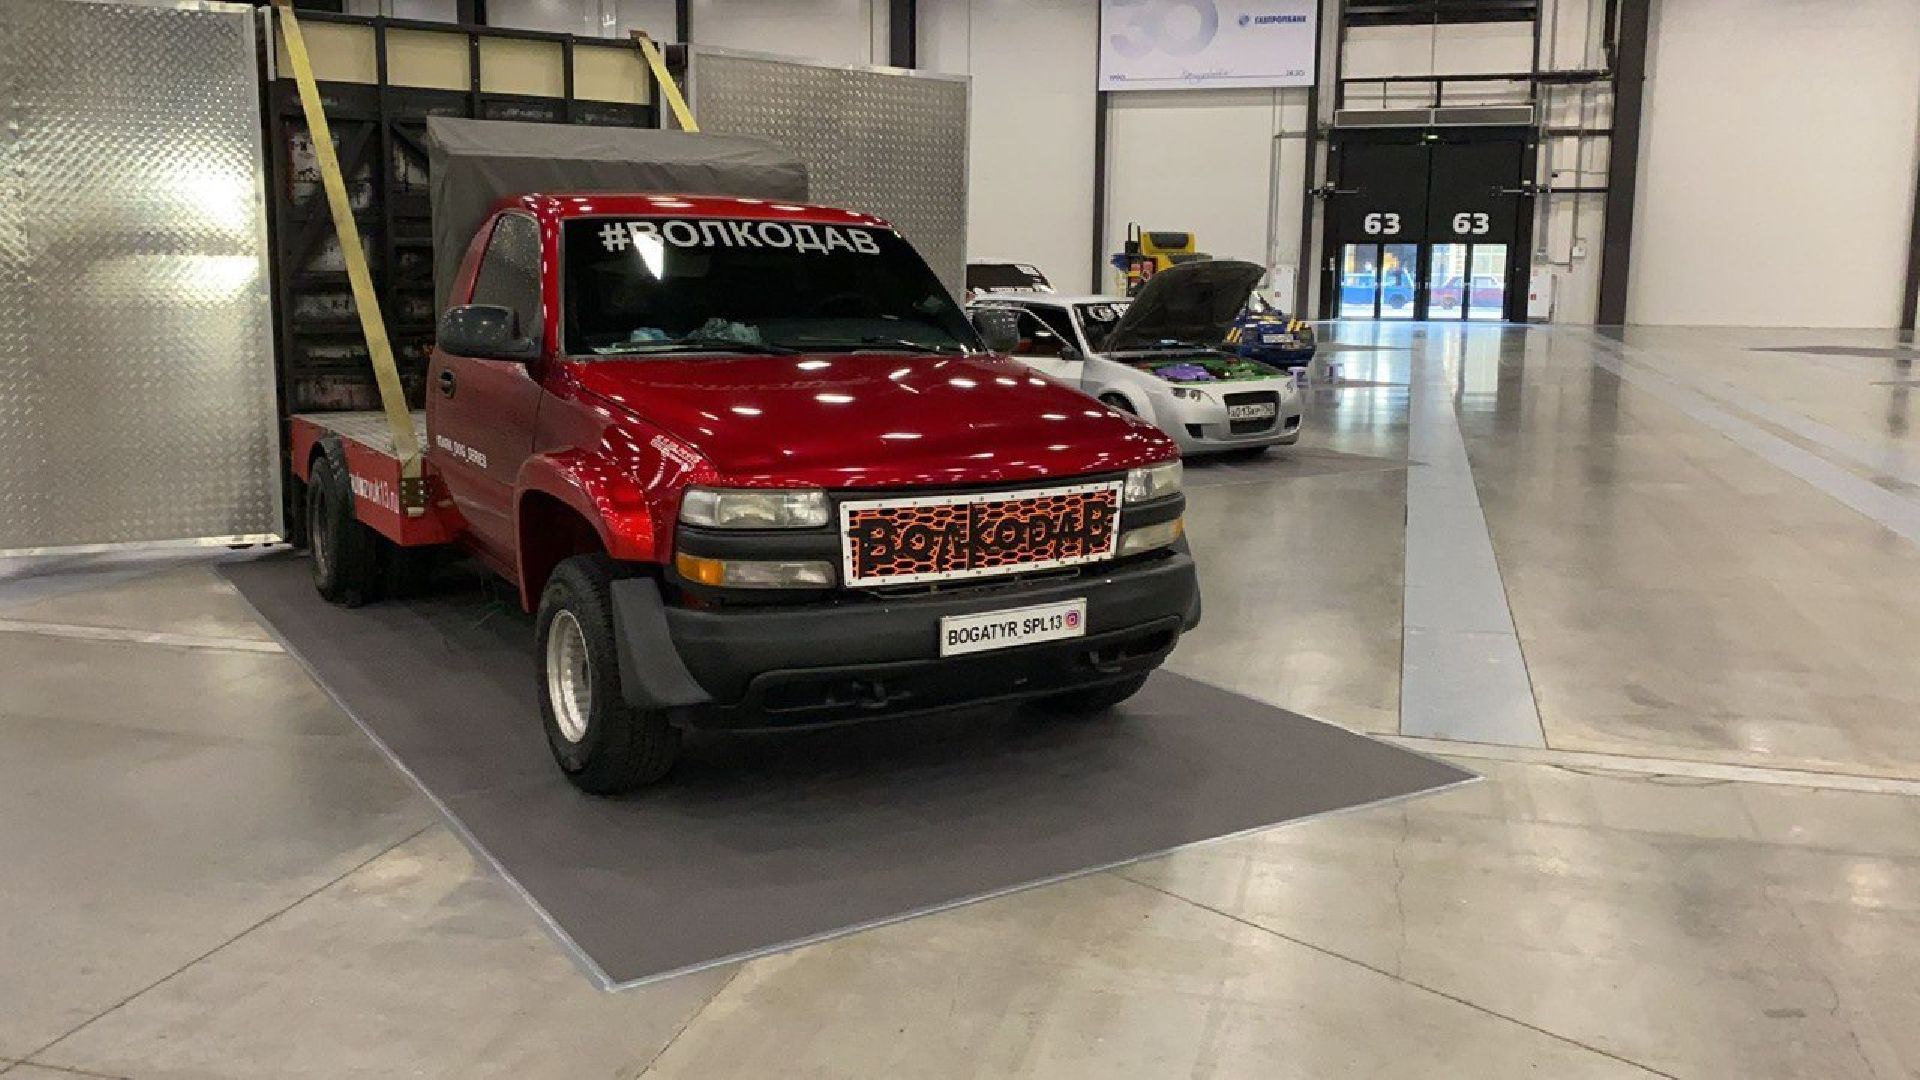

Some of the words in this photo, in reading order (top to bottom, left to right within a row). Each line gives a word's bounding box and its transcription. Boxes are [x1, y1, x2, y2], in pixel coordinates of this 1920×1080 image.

[1364, 213, 1401, 235] 63
[1453, 213, 1490, 235] 63
[598, 220, 881, 255] #ВОЛКОДАВ
